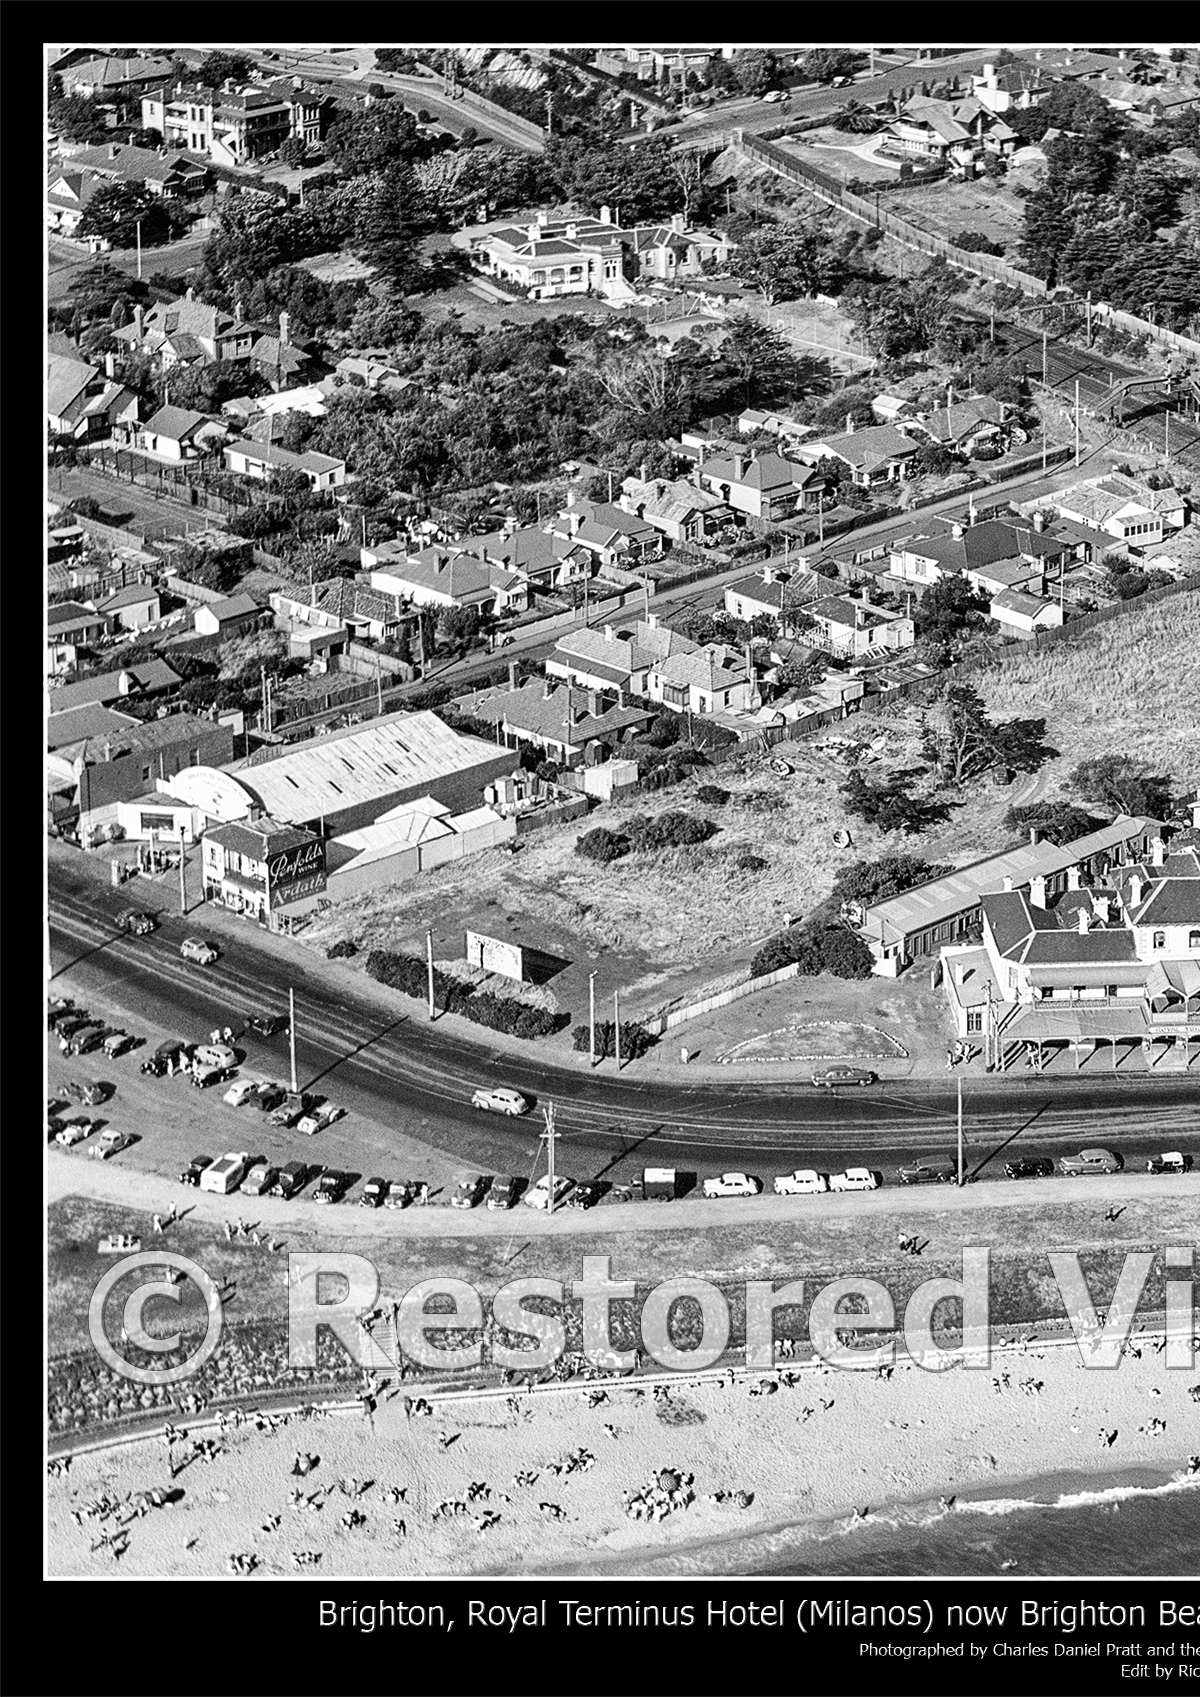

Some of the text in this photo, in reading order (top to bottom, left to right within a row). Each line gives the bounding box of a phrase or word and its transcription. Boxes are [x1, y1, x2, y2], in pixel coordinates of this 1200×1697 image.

[270, 843, 323, 887] Penfolds
[299, 862, 318, 873] WINE
[272, 873, 325, 908] Ardath
